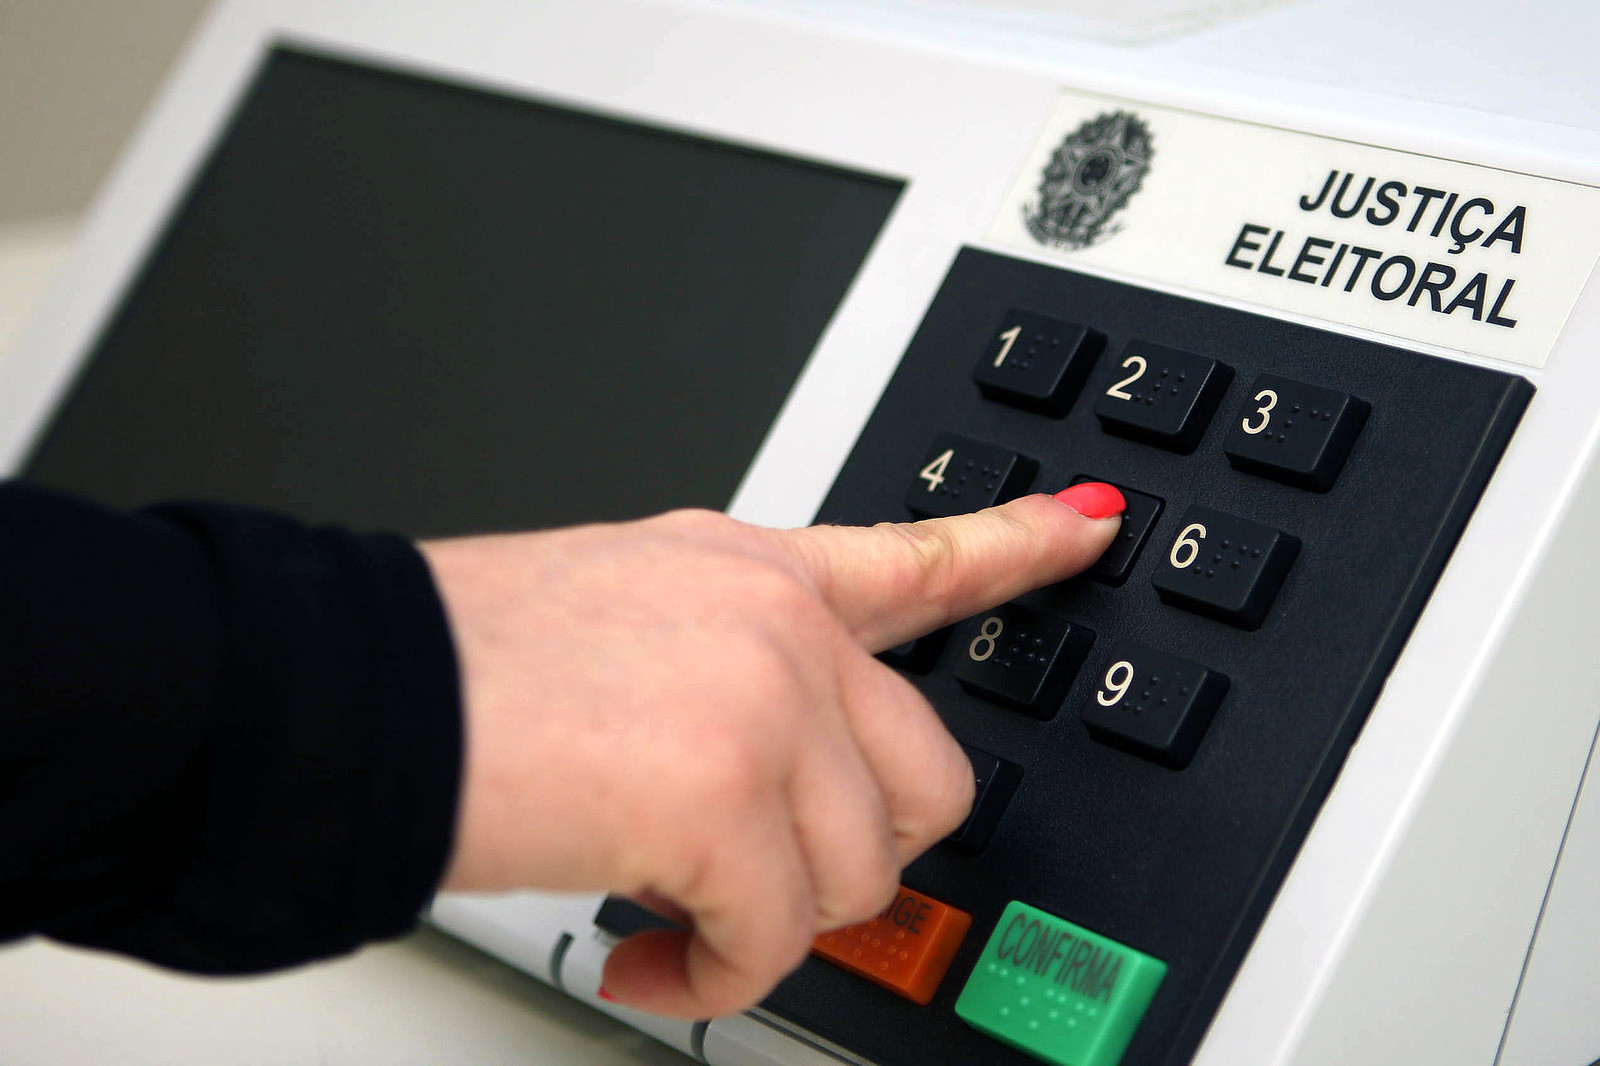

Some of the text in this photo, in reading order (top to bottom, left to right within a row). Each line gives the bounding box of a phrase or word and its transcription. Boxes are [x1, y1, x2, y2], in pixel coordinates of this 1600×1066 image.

[1299, 170, 1527, 254] JUSTIÇA
[1225, 223, 1518, 329] ELEITORAL
[994, 326, 1022, 367] 1
[1106, 355, 1148, 401] 2
[1242, 389, 1278, 435] 3
[919, 449, 954, 492] 4
[1169, 523, 1207, 569] 6
[968, 616, 1003, 662] 8
[1096, 660, 1134, 707] 9
[998, 912, 1125, 1002] CONFIRMA
